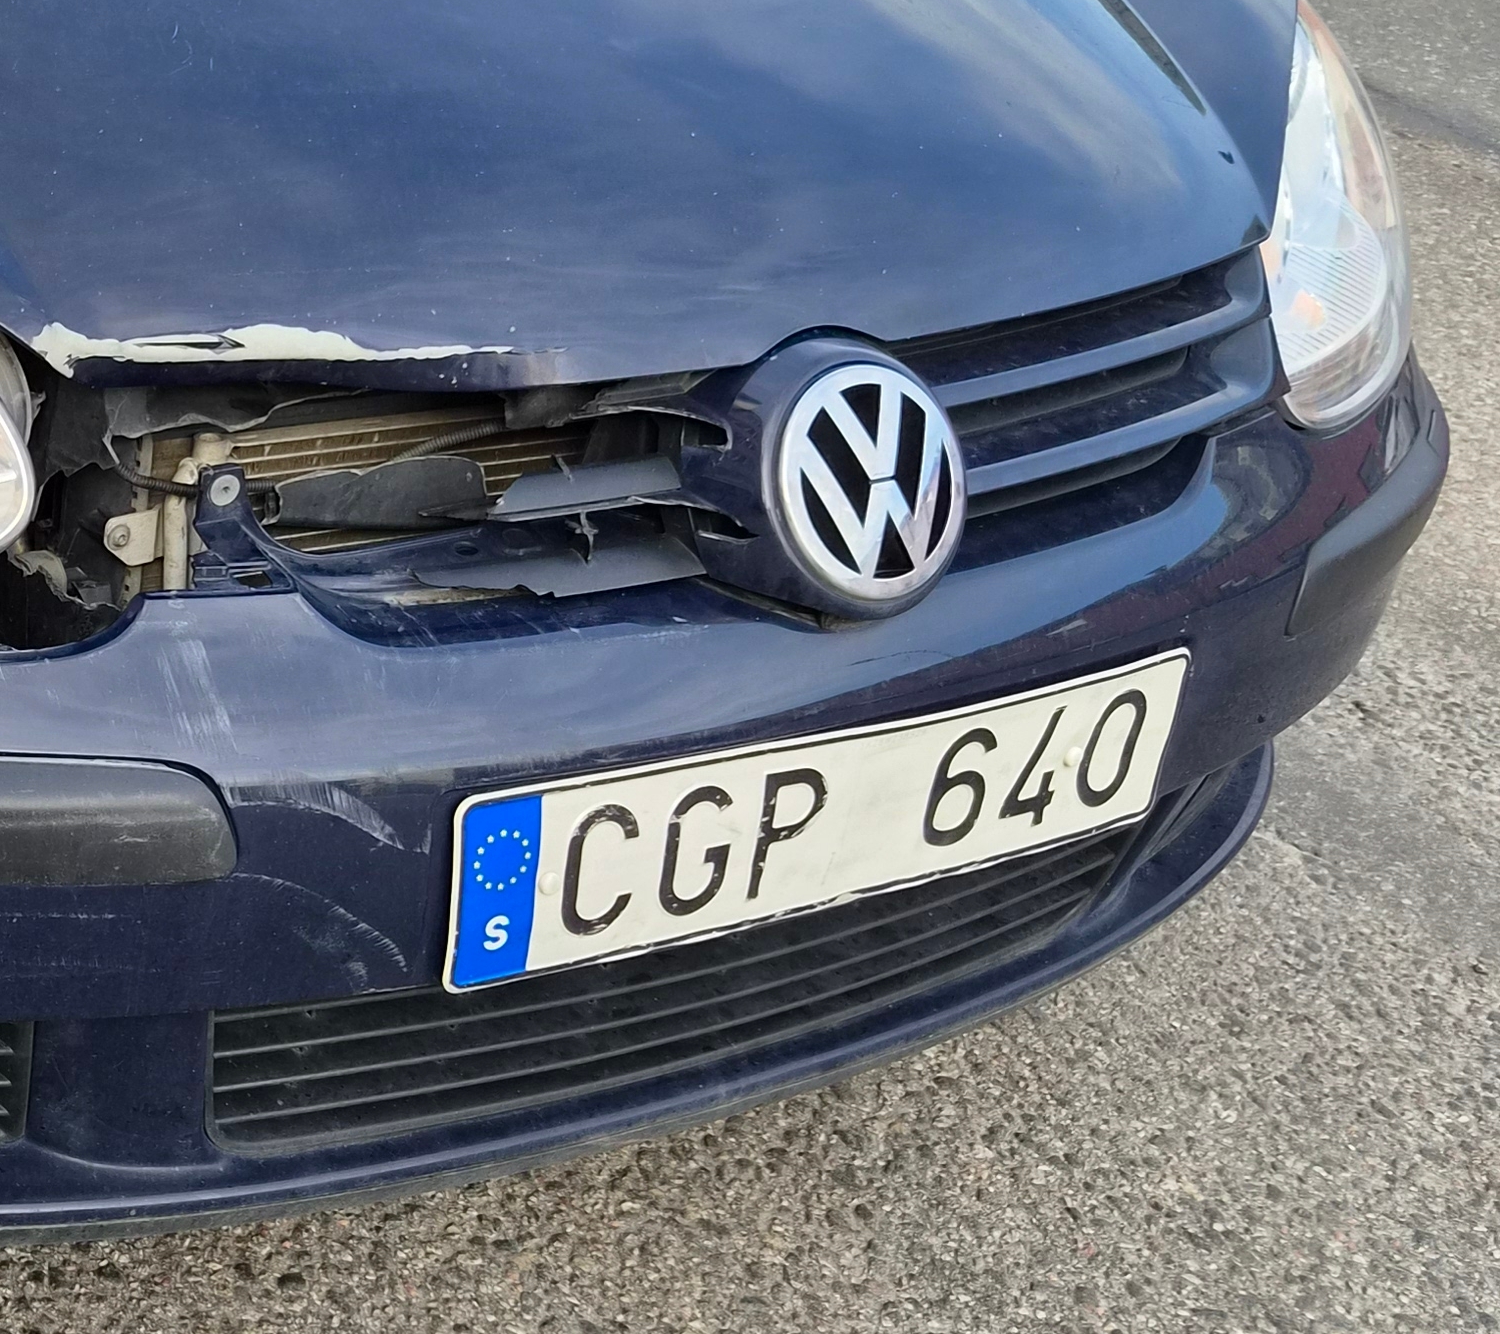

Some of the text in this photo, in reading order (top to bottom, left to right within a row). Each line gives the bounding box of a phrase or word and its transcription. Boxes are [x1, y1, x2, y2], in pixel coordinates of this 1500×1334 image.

[561, 688, 1148, 936] CGP 640
[482, 914, 509, 951] S
